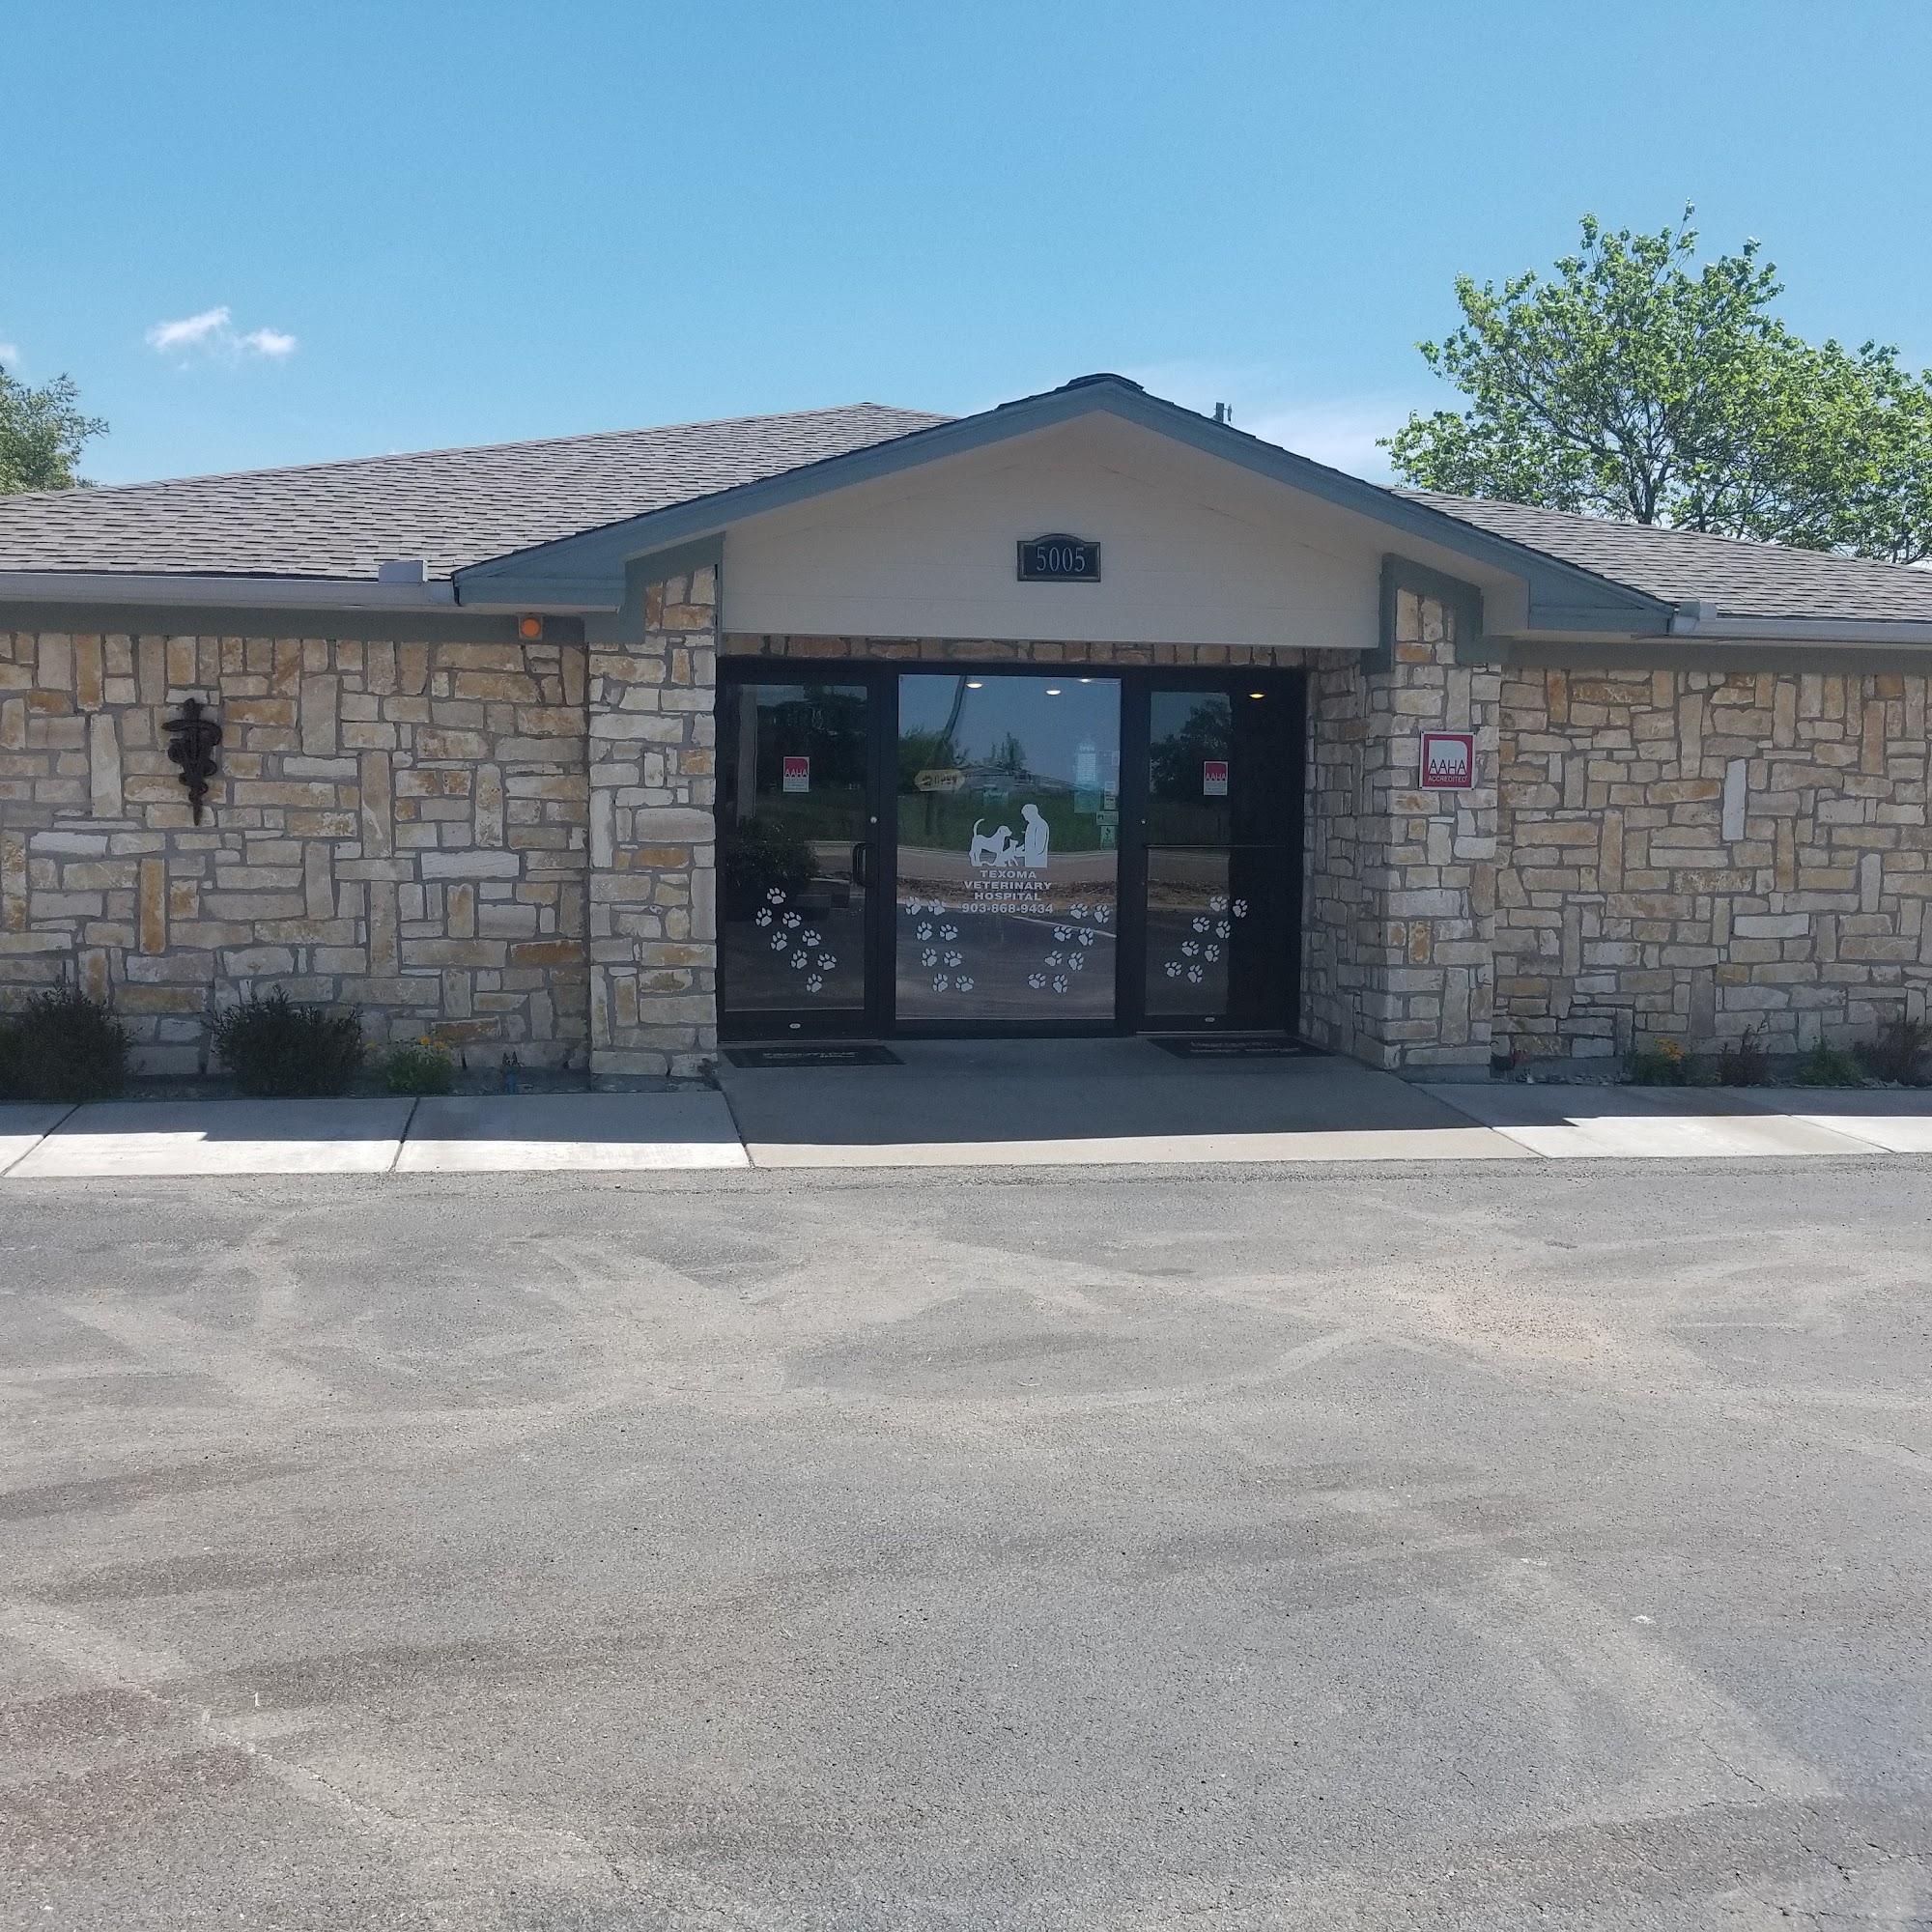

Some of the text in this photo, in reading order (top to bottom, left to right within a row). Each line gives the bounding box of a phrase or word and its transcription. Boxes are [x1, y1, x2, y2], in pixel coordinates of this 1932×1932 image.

[1037, 547, 1085, 572] 5005
[1429, 758, 1466, 774] AAHA
[784, 768, 808, 778] AAHA
[980, 870, 1037, 879] TEXOMA
[964, 881, 1052, 891] VETERINARY
[974, 893, 1041, 901] HOSPITAL
[961, 903, 1054, 914] 903-868-9434
